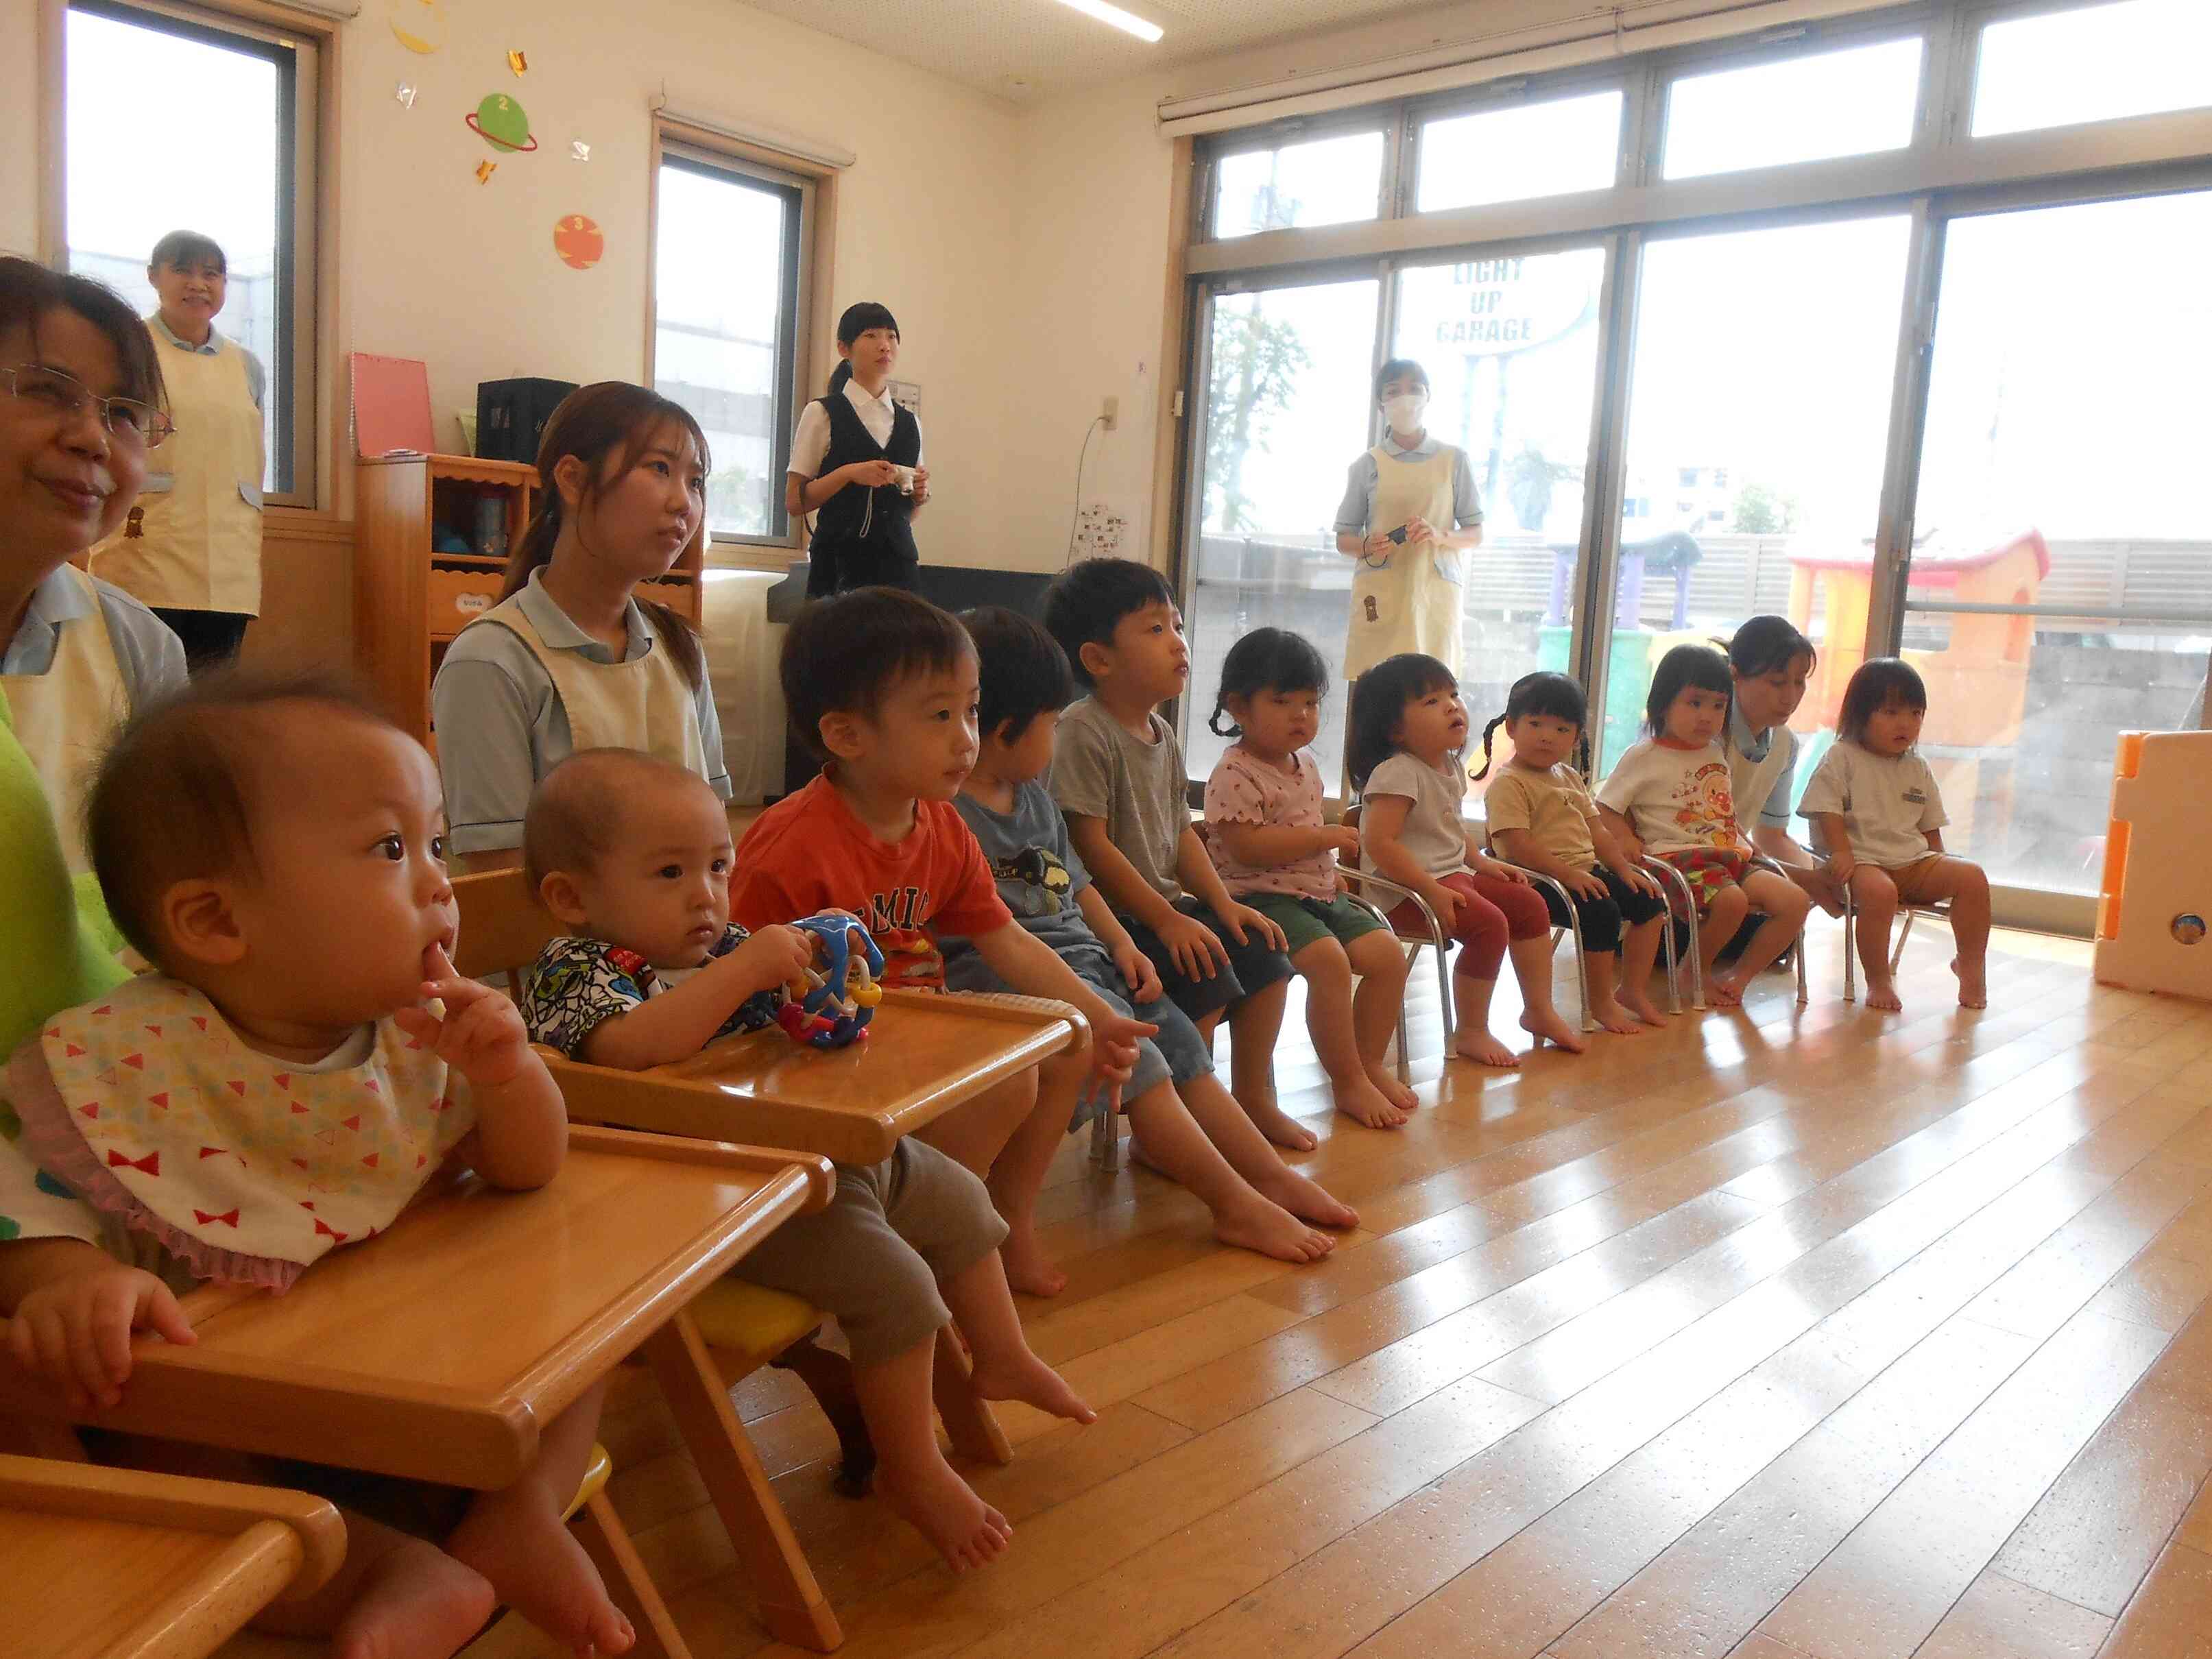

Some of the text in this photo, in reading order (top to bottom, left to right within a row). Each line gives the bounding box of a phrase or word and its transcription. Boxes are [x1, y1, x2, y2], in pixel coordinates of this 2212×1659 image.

[498, 97, 508, 110] 2
[574, 217, 584, 231] 3
[1453, 257, 1526, 285] LIGHT
[1470, 291, 1503, 315] UP
[1436, 317, 1532, 343] GARAGE
